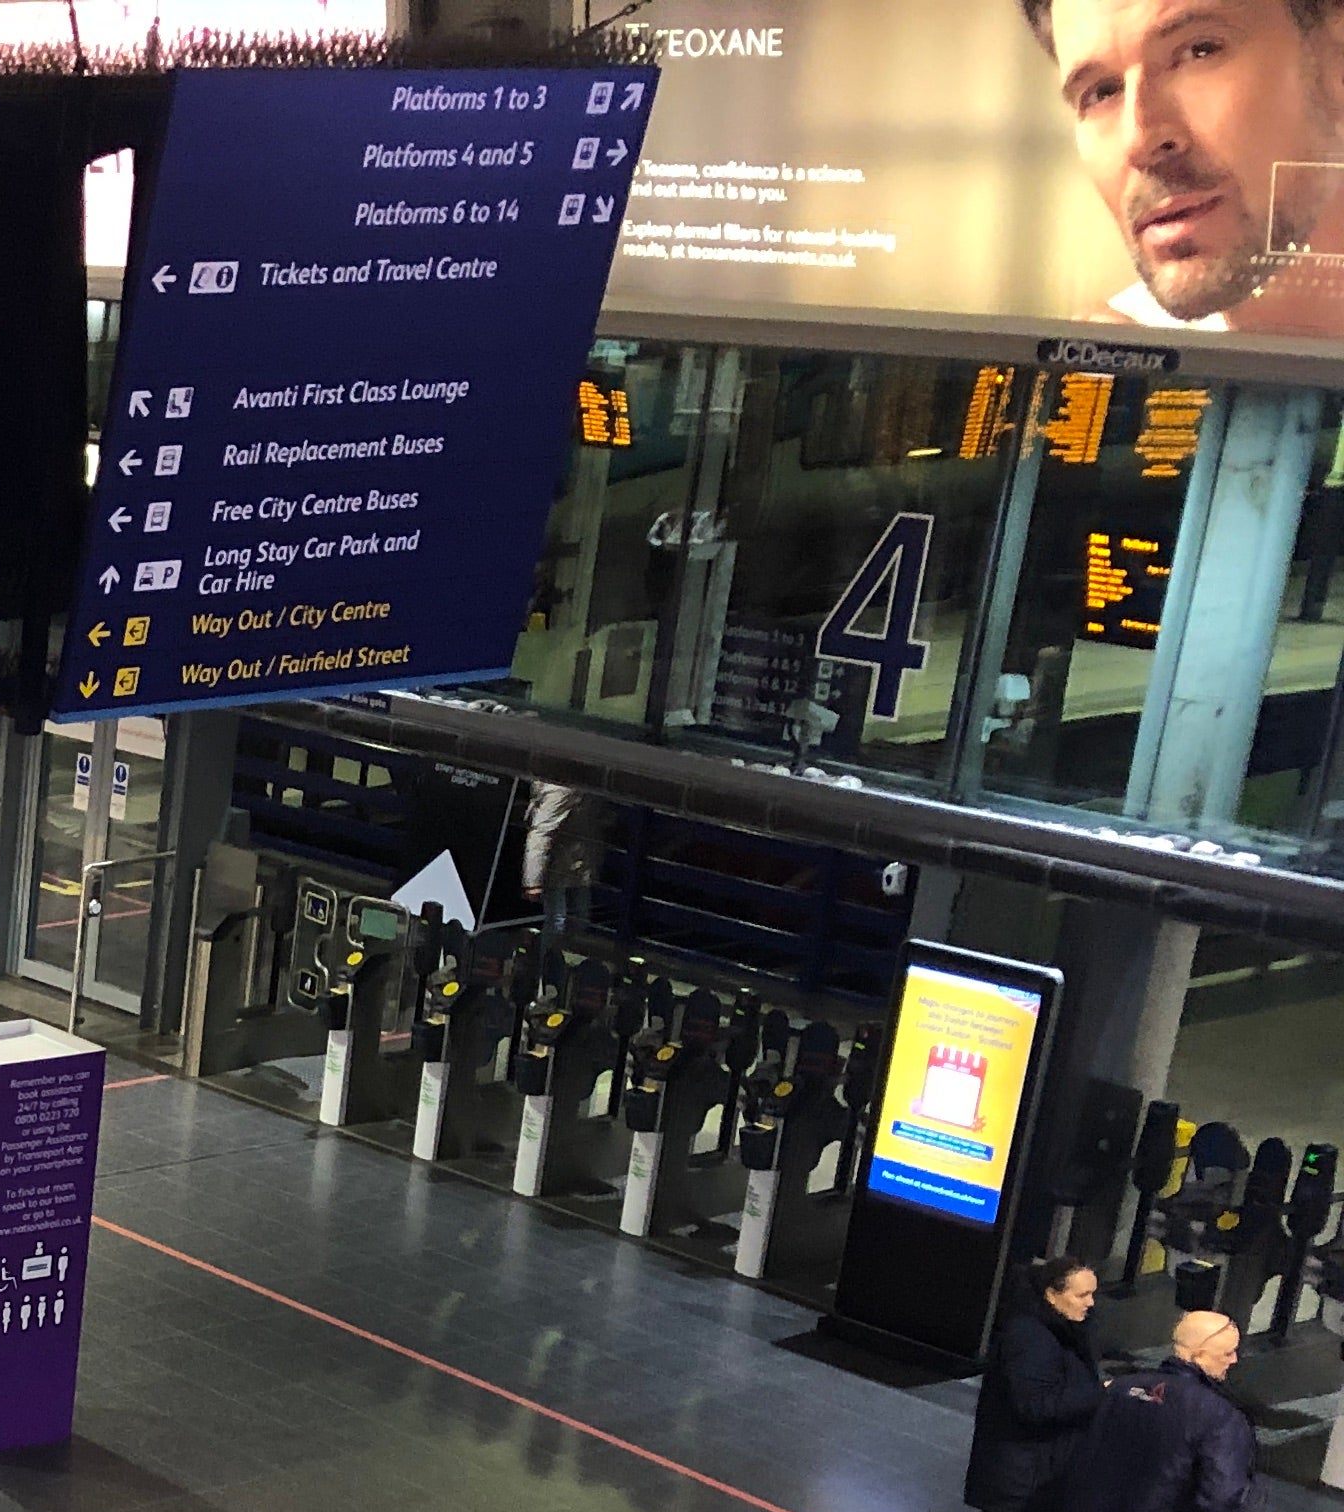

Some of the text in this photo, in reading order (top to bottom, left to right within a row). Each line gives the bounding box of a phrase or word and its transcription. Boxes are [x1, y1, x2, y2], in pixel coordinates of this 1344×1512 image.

[392, 86, 547, 111] Platforms 1 to 3
[363, 141, 534, 168] Platforms 4 and 5
[703, 160, 779, 181] confidence
[781, 163, 793, 181] is
[796, 168, 805, 181] a
[807, 164, 865, 183] science.
[631, 181, 788, 204] ind out what it is to you.
[355, 199, 518, 226] Platforms 6 to 14
[623, 220, 672, 240] Explore
[675, 222, 721, 240] dermal
[724, 223, 761, 242] fillers
[763, 225, 784, 242] for
[623, 242, 669, 261] results,
[672, 244, 686, 259] at
[260, 256, 497, 286] Tickets and Travel Centre
[1049, 342, 1168, 369] JCDecaux
[233, 378, 469, 409] Avanti First Class Lounge
[223, 433, 444, 468] Rail Replacement Buses
[212, 489, 419, 523] Free City Centre Buses
[204, 530, 420, 569] Long Stay Car Park and
[199, 570, 274, 594] Car Hire
[192, 600, 390, 638] Way Out City Centre
[815, 511, 934, 721] 4
[182, 644, 410, 688] Way Out Fairfield Street
[11, 1072, 90, 1088] Remember you can
[18, 1085, 83, 1100] book assistance
